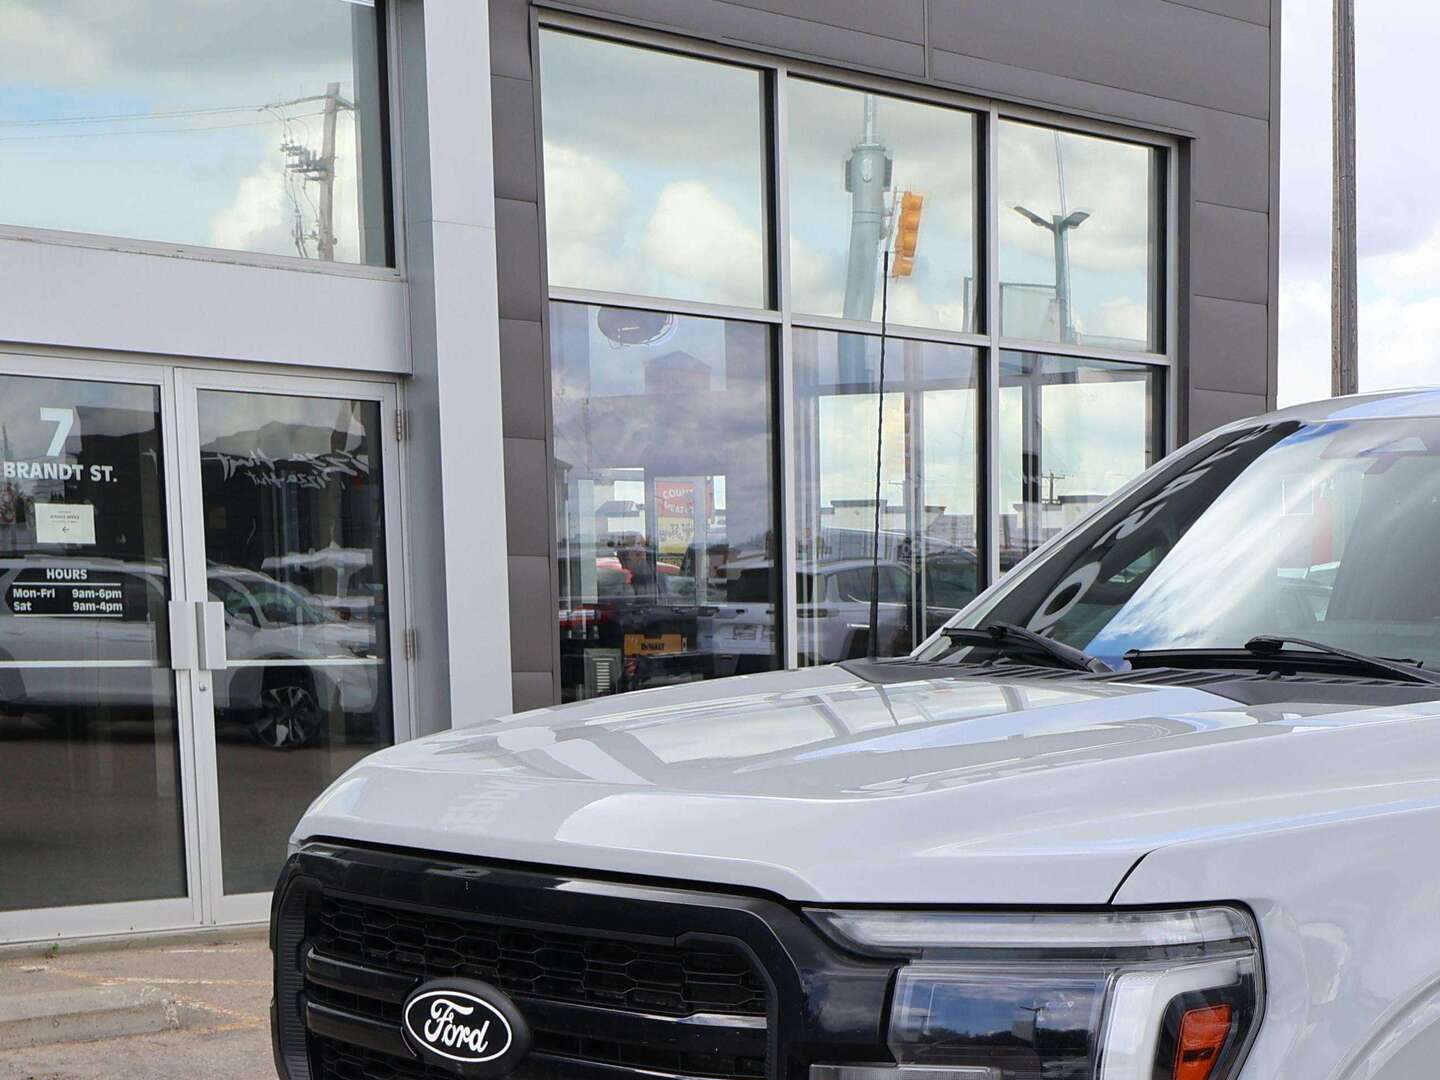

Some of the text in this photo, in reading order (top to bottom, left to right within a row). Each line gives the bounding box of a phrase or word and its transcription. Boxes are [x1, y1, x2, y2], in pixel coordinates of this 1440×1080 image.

[40, 407, 73, 456] 7
[3, 461, 118, 482] BRANDT ST.
[46, 568, 88, 580] HOURS
[13, 588, 122, 600] Mon-Fri 9am-6pm
[13, 601, 123, 613] Sat 9am-4pm
[424, 998, 490, 1053] Ford
